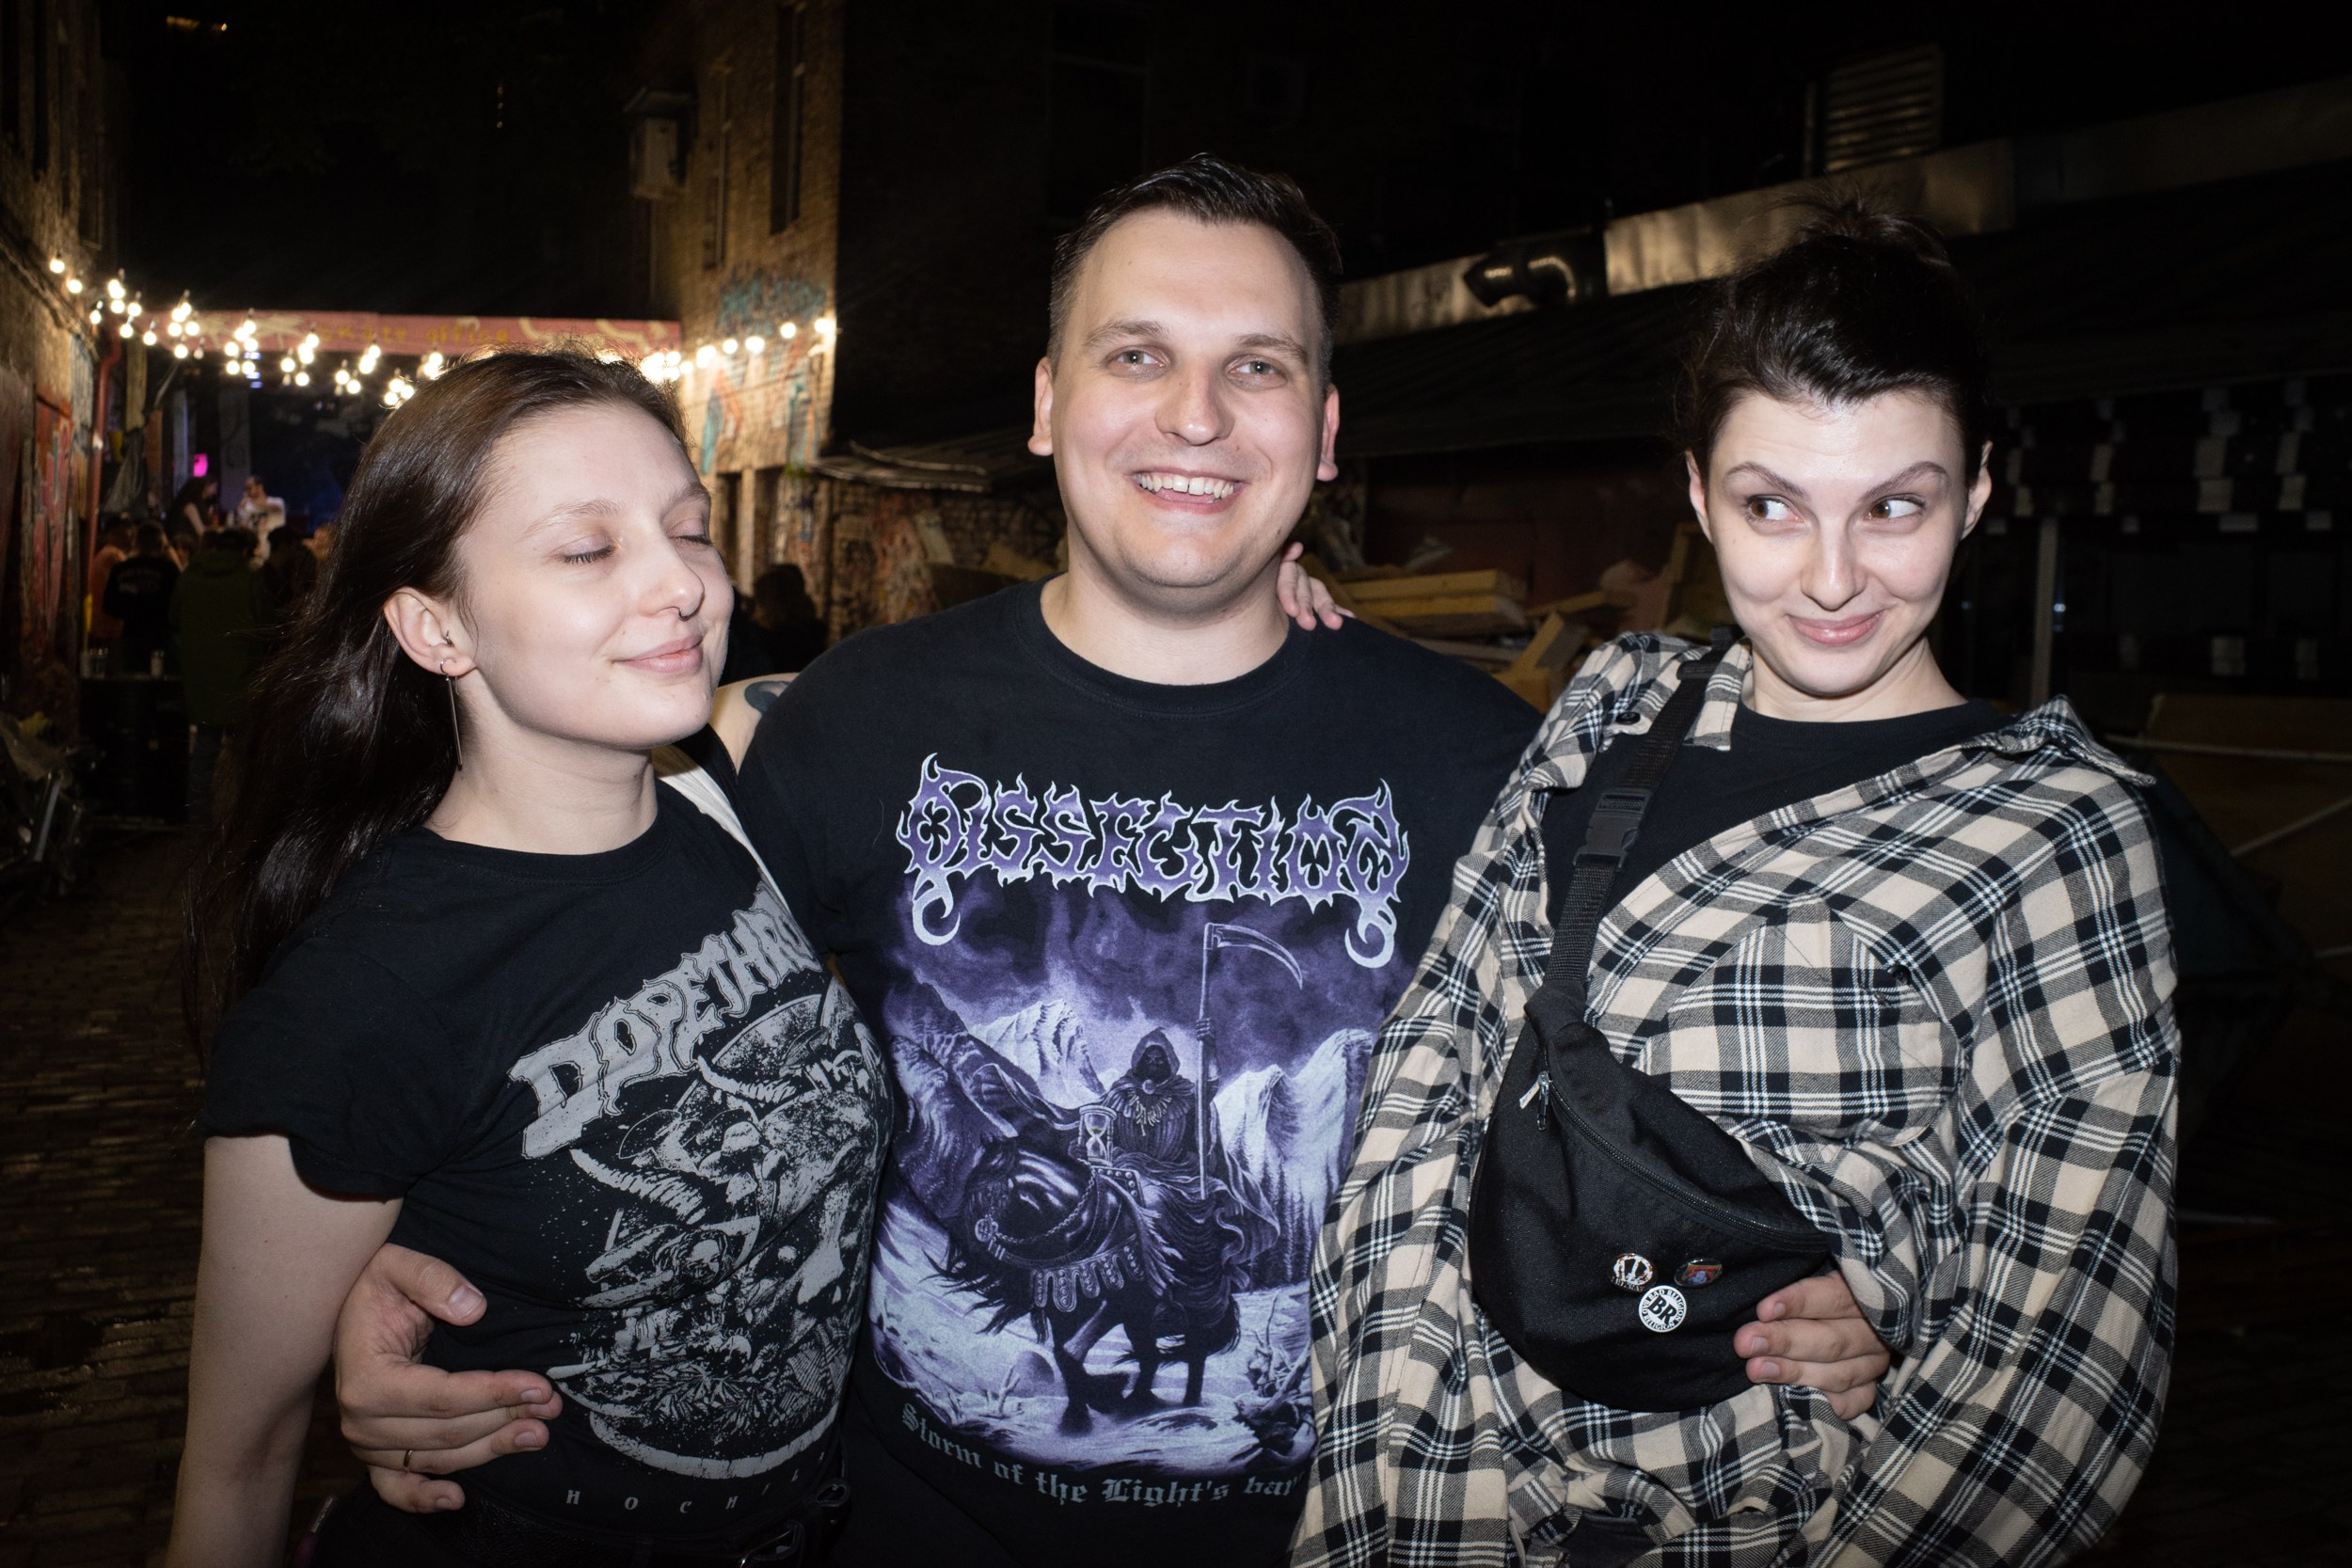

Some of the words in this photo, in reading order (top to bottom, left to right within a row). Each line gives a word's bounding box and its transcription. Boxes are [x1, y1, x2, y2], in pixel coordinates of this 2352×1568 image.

[895, 752, 1410, 969] DISSECTION
[1648, 1294, 1677, 1326] BR
[901, 1403, 982, 1469] Storm
[993, 1460, 1025, 1486] of
[1035, 1473, 1089, 1506] the
[1101, 1478, 1230, 1508] Light's
